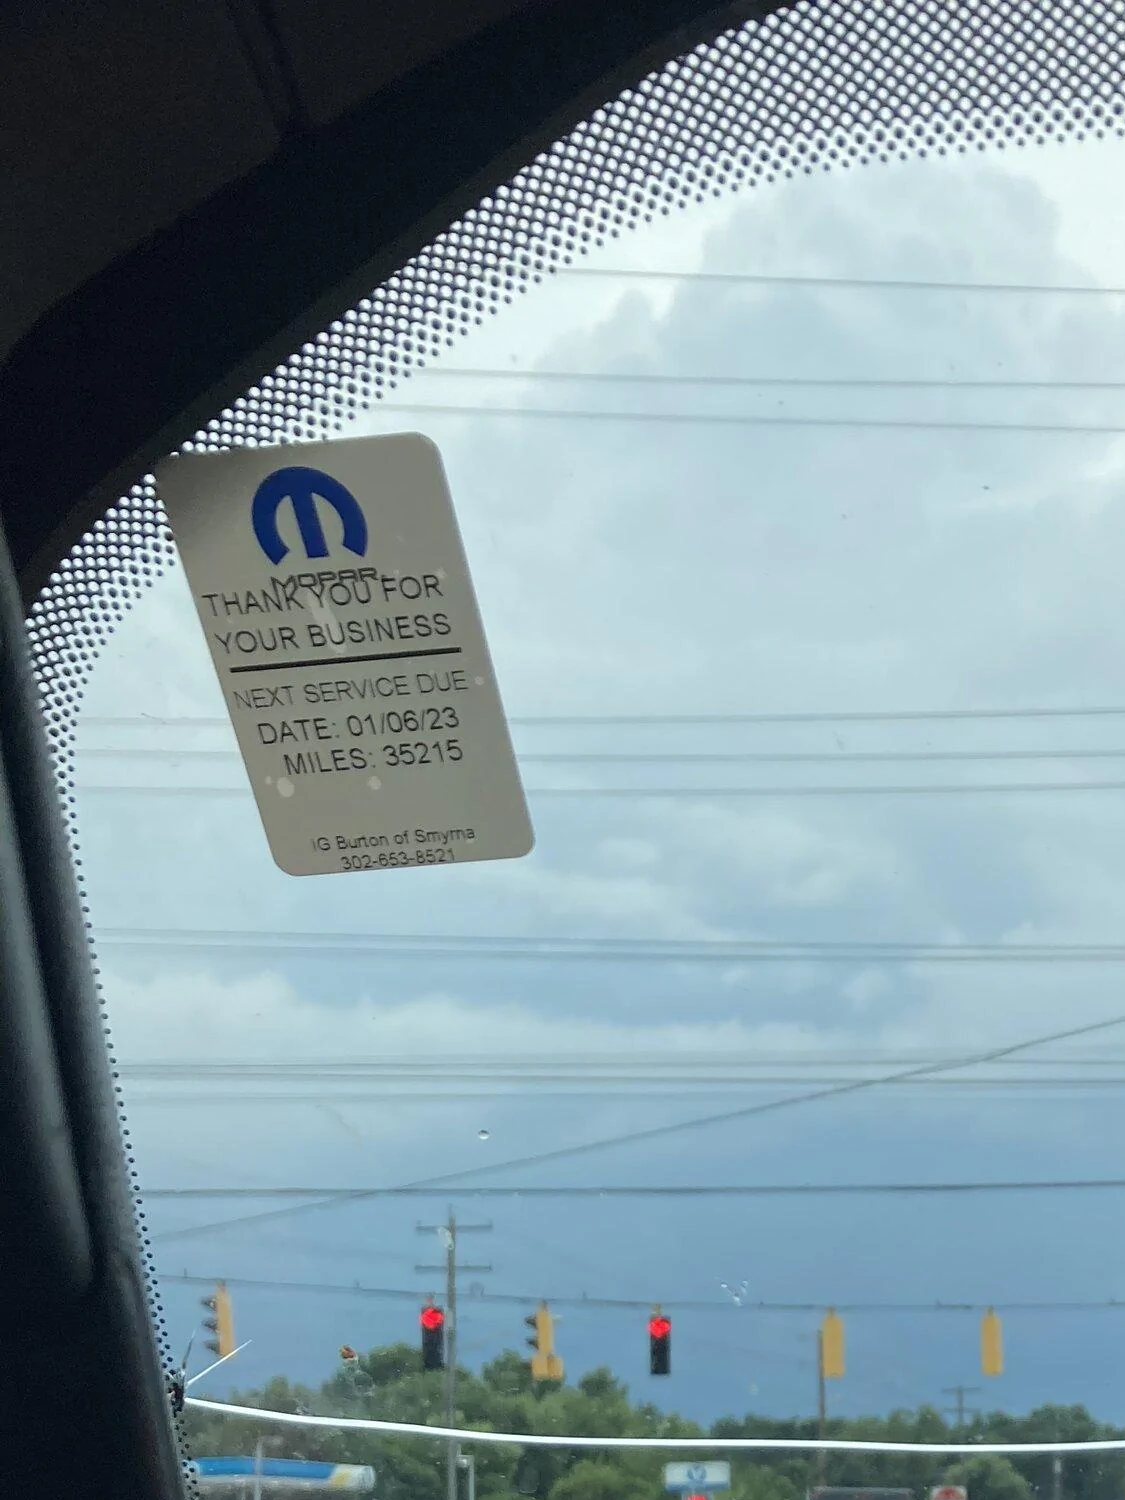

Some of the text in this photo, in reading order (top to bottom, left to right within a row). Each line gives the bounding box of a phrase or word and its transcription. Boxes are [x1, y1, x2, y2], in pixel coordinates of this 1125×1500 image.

[202, 574, 443, 617] THANK YOU FOR
[271, 567, 378, 589] MOPAR
[214, 613, 451, 654] YOUR BUSINESS
[233, 670, 469, 709] NEXT SERVICE DUE
[257, 707, 459, 744] DATE: 01/06/23
[284, 740, 463, 775] MILES: 35215
[336, 834, 388, 851] Burton
[394, 830, 410, 846] of
[416, 827, 475, 846] Smyrna
[340, 848, 456, 870] 302-653-8521
